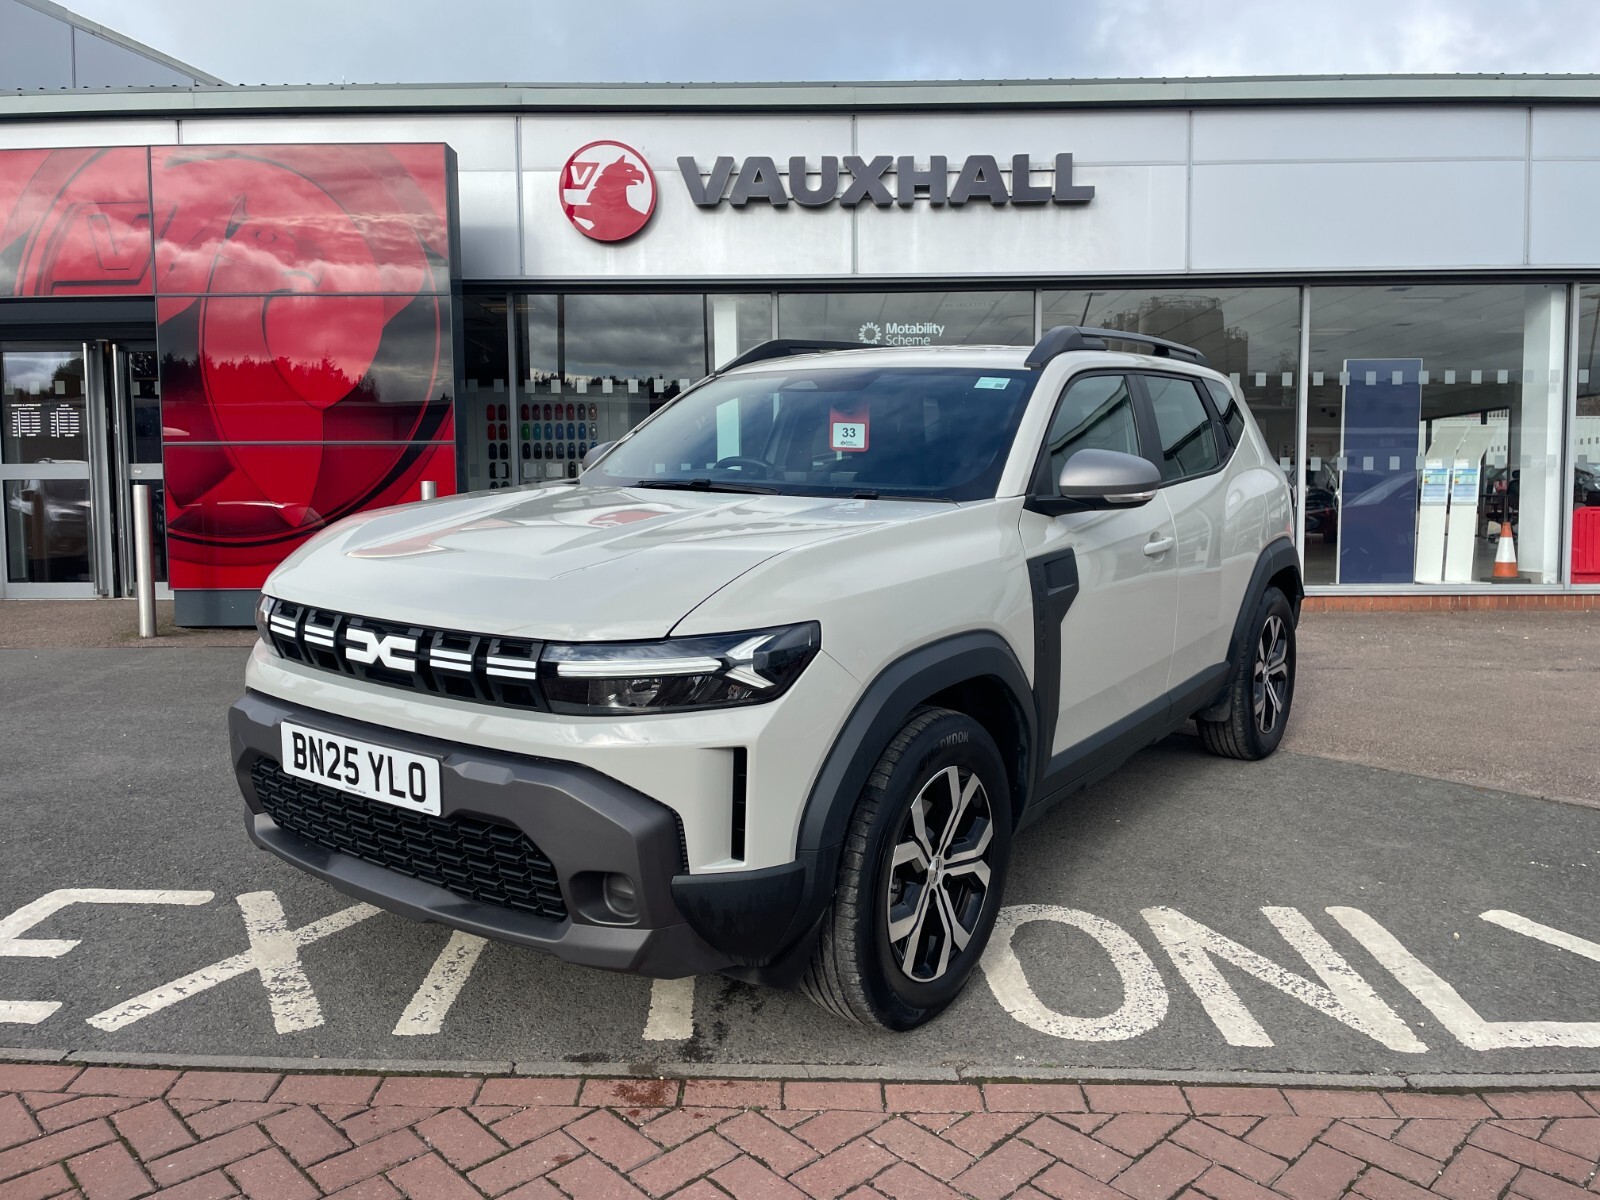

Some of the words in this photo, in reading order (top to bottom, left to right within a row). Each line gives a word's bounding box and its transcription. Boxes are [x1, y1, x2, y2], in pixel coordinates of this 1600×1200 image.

[677, 152, 1095, 207] VAUXHALL
[886, 322, 945, 336] Motability
[886, 334, 931, 346] Scheme
[842, 427, 856, 438] 33
[292, 731, 359, 785] BN25
[368, 751, 426, 803] YLO
